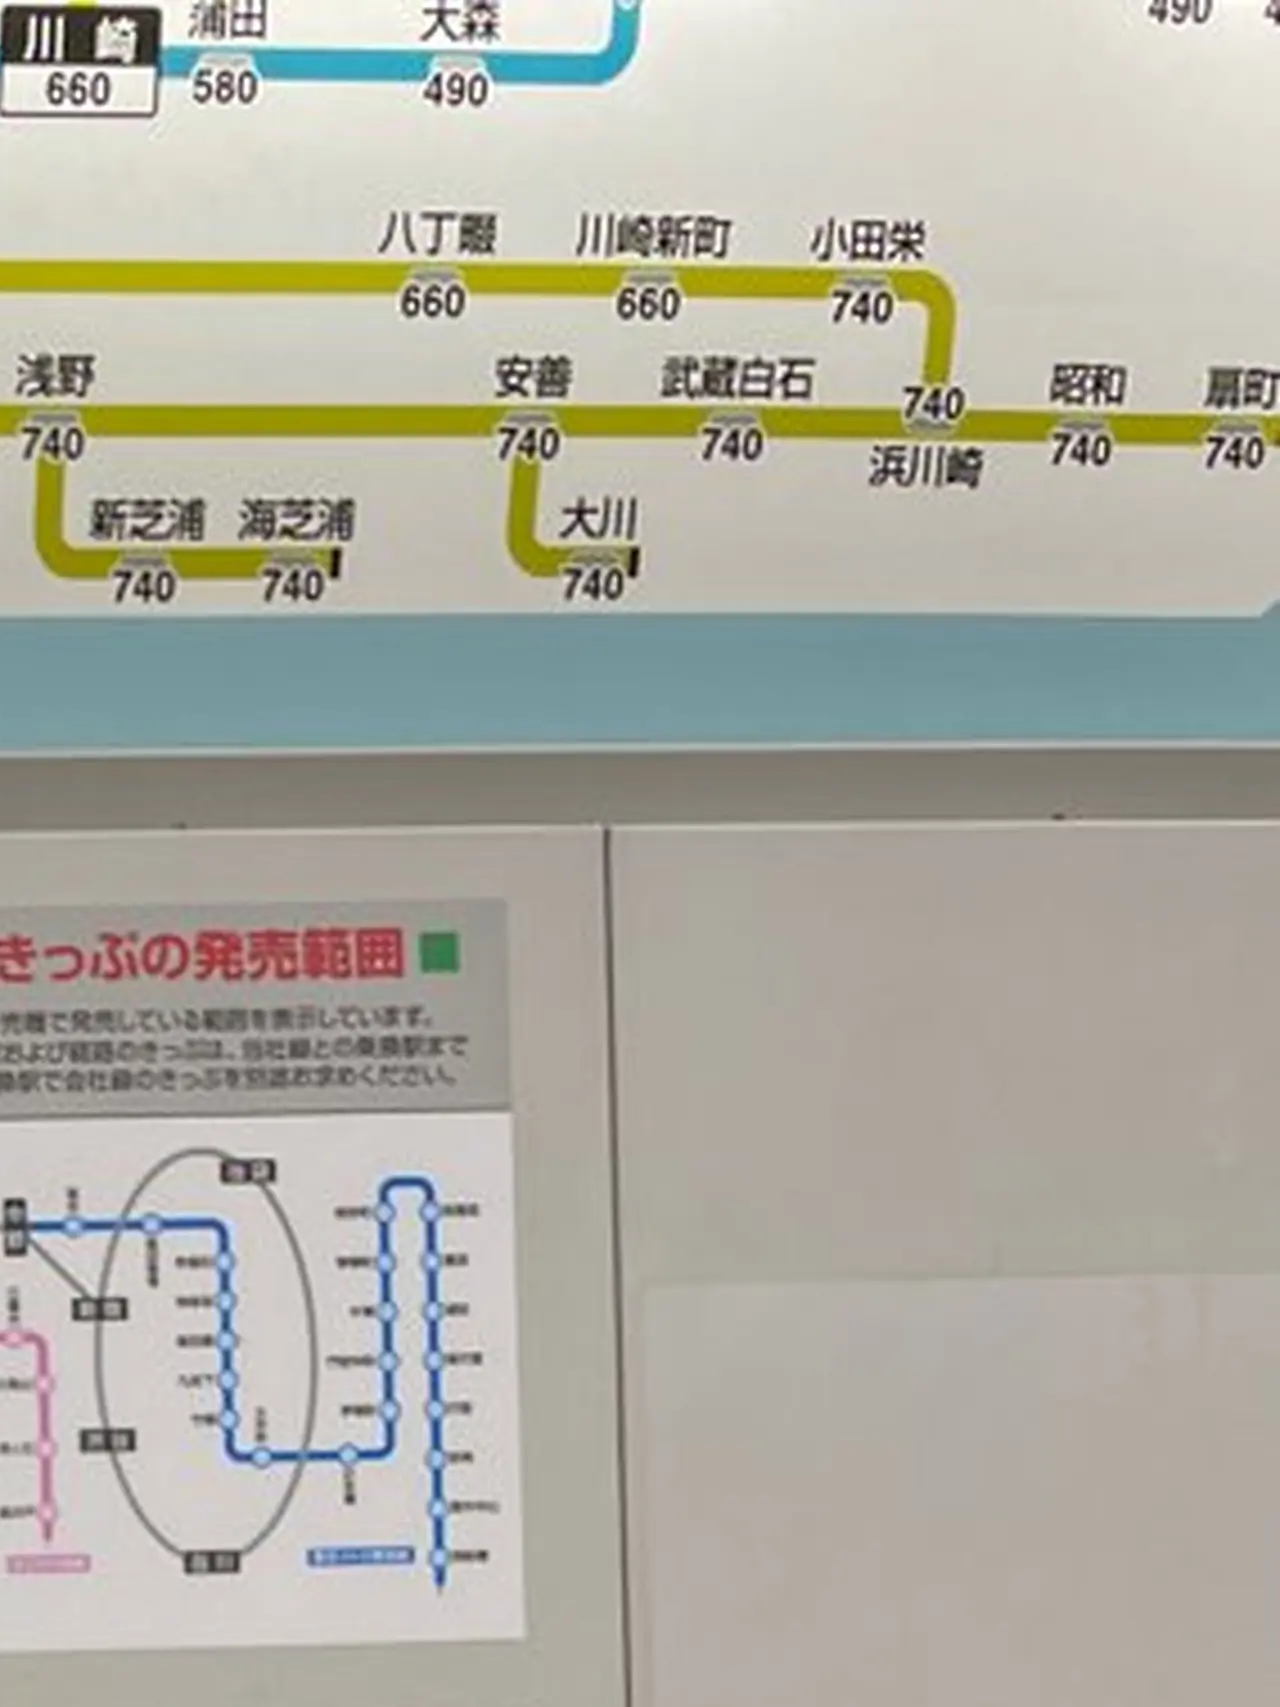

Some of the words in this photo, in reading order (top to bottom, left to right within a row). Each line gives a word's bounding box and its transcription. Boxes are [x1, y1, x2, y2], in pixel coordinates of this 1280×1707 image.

[421, 0, 502, 42] 大森
[22, 15, 139, 63] 川崎
[46, 71, 111, 106] 660
[192, 69, 258, 104] 580
[423, 72, 489, 107] 490
[575, 214, 732, 259] 川崎新町
[811, 219, 926, 262] 小田栄
[400, 285, 466, 319] 660
[616, 287, 681, 321] 660
[830, 289, 893, 324] 740
[16, 356, 96, 398] 浅野
[495, 357, 573, 399] 安善
[661, 357, 816, 400] 武蔵白石
[1050, 364, 1126, 406] 昭和
[1205, 368, 1280, 410] 扇町
[903, 387, 965, 421] 740
[21, 426, 85, 460] 740
[497, 427, 560, 461] 740
[702, 427, 764, 461] 740
[1050, 432, 1112, 467] 740
[1203, 435, 1265, 470] 740
[868, 447, 984, 488] 浜川崎
[90, 498, 205, 541] 新芝浦
[238, 498, 355, 541] 海芝浦
[560, 498, 637, 541] 大川
[113, 569, 176, 604] 740
[261, 569, 325, 604] 740
[562, 566, 624, 600] 740
